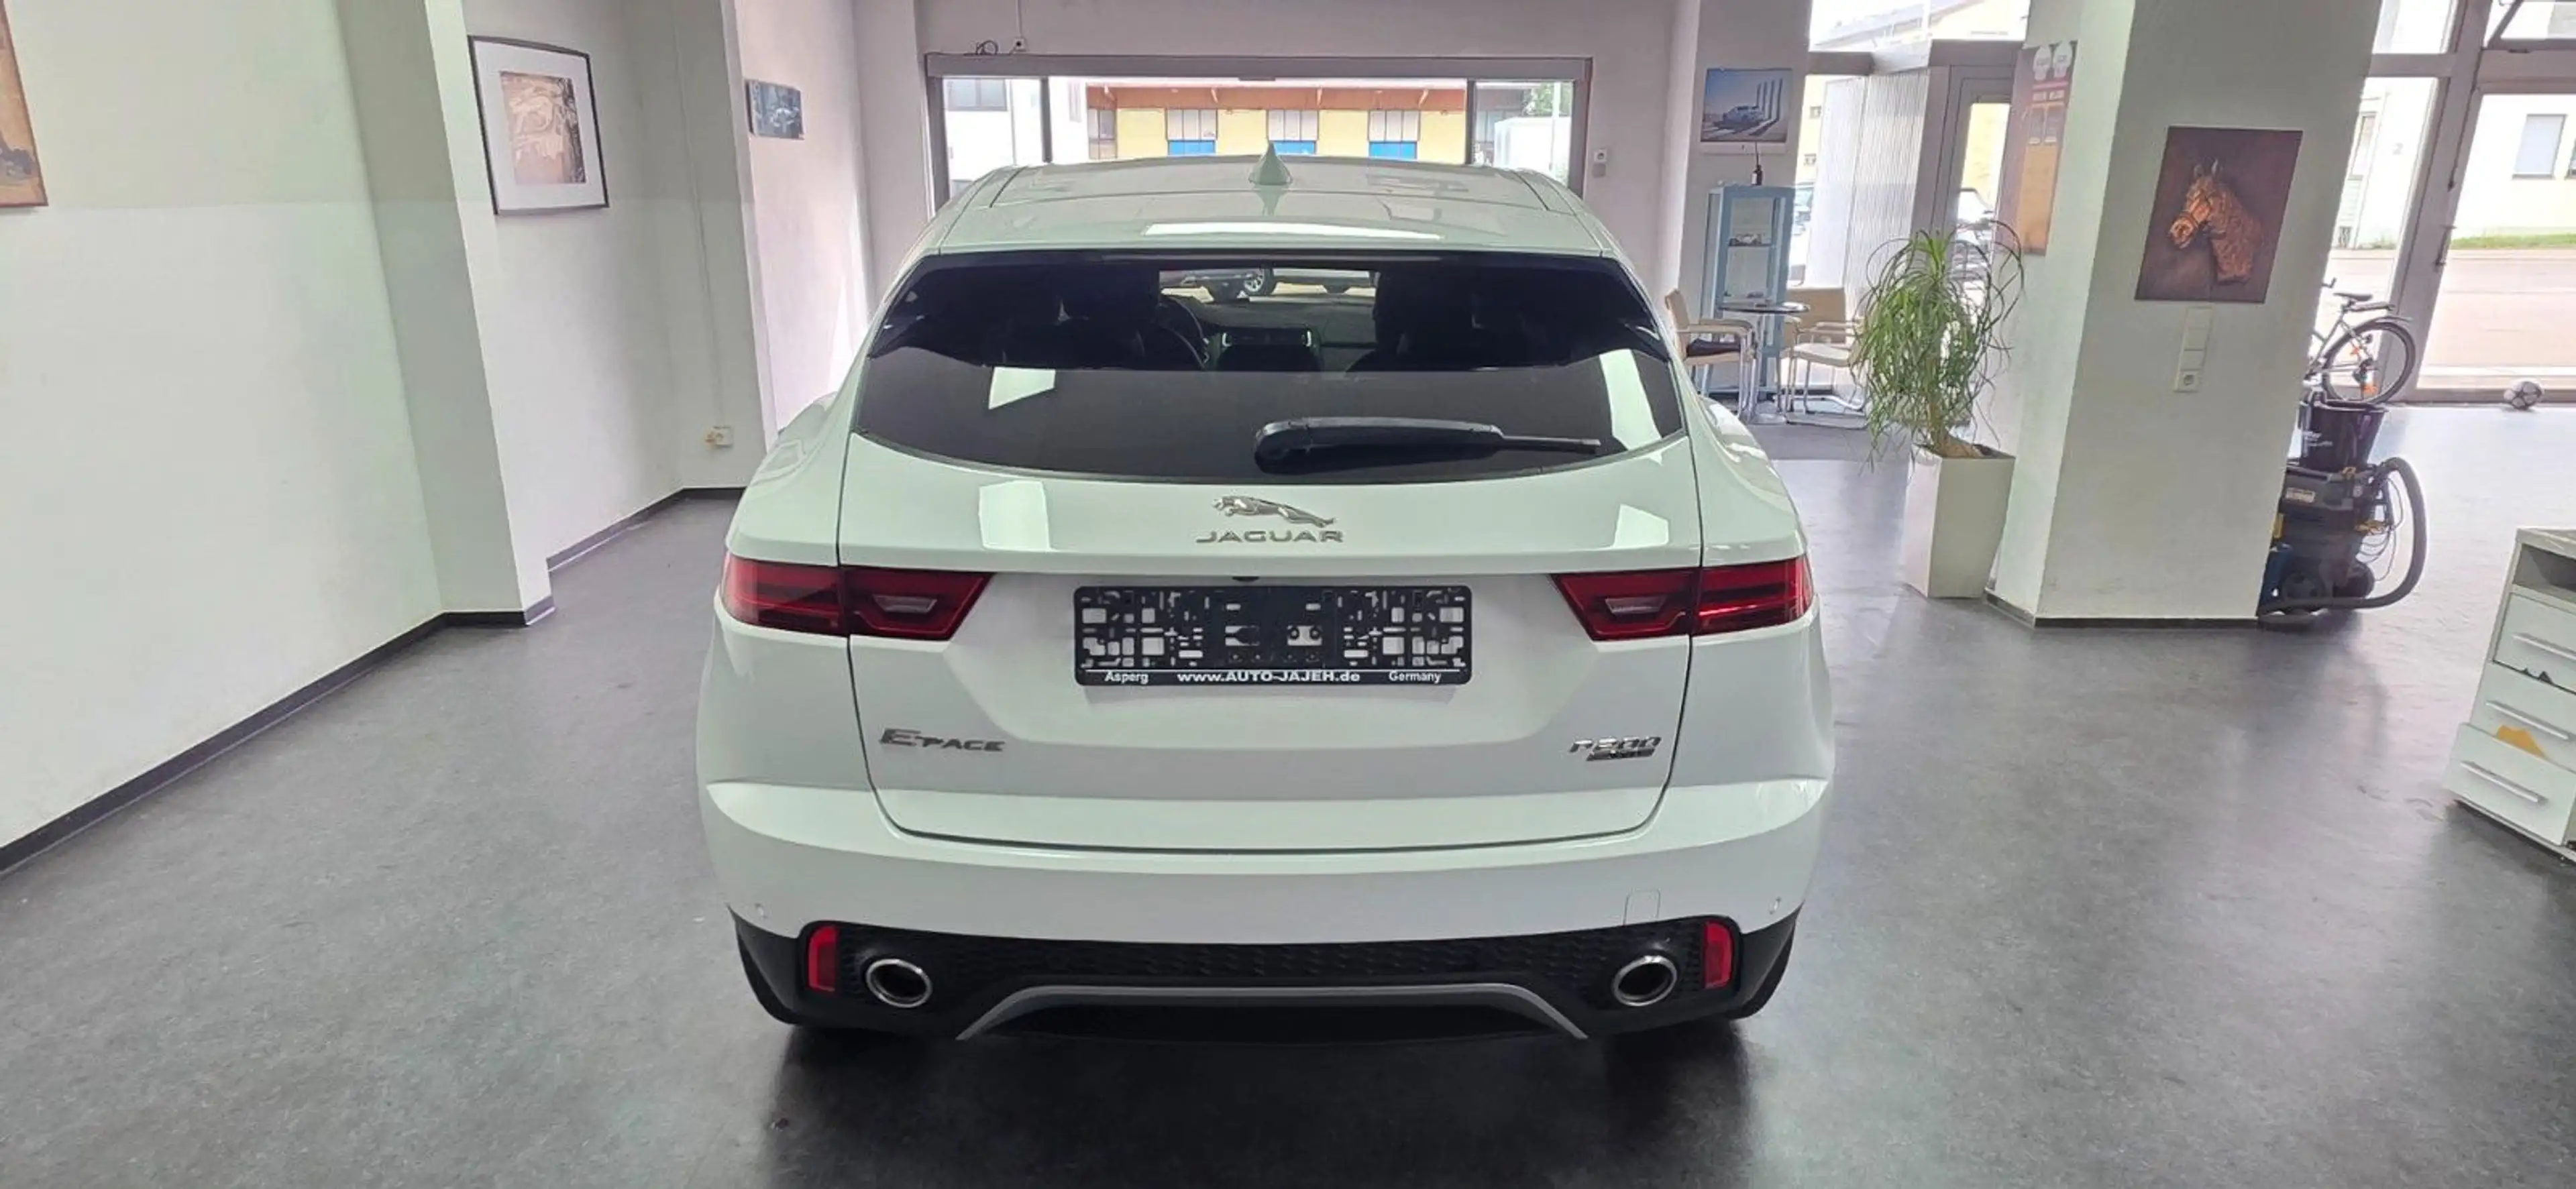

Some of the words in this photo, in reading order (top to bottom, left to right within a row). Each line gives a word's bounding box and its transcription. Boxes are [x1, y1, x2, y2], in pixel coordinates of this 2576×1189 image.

[1195, 530, 1344, 543] JAGUAR
[1104, 671, 1148, 684] Asperg
[1177, 670, 1360, 682] www.AUTO-JAJEH.de
[1389, 671, 1442, 684] Germany
